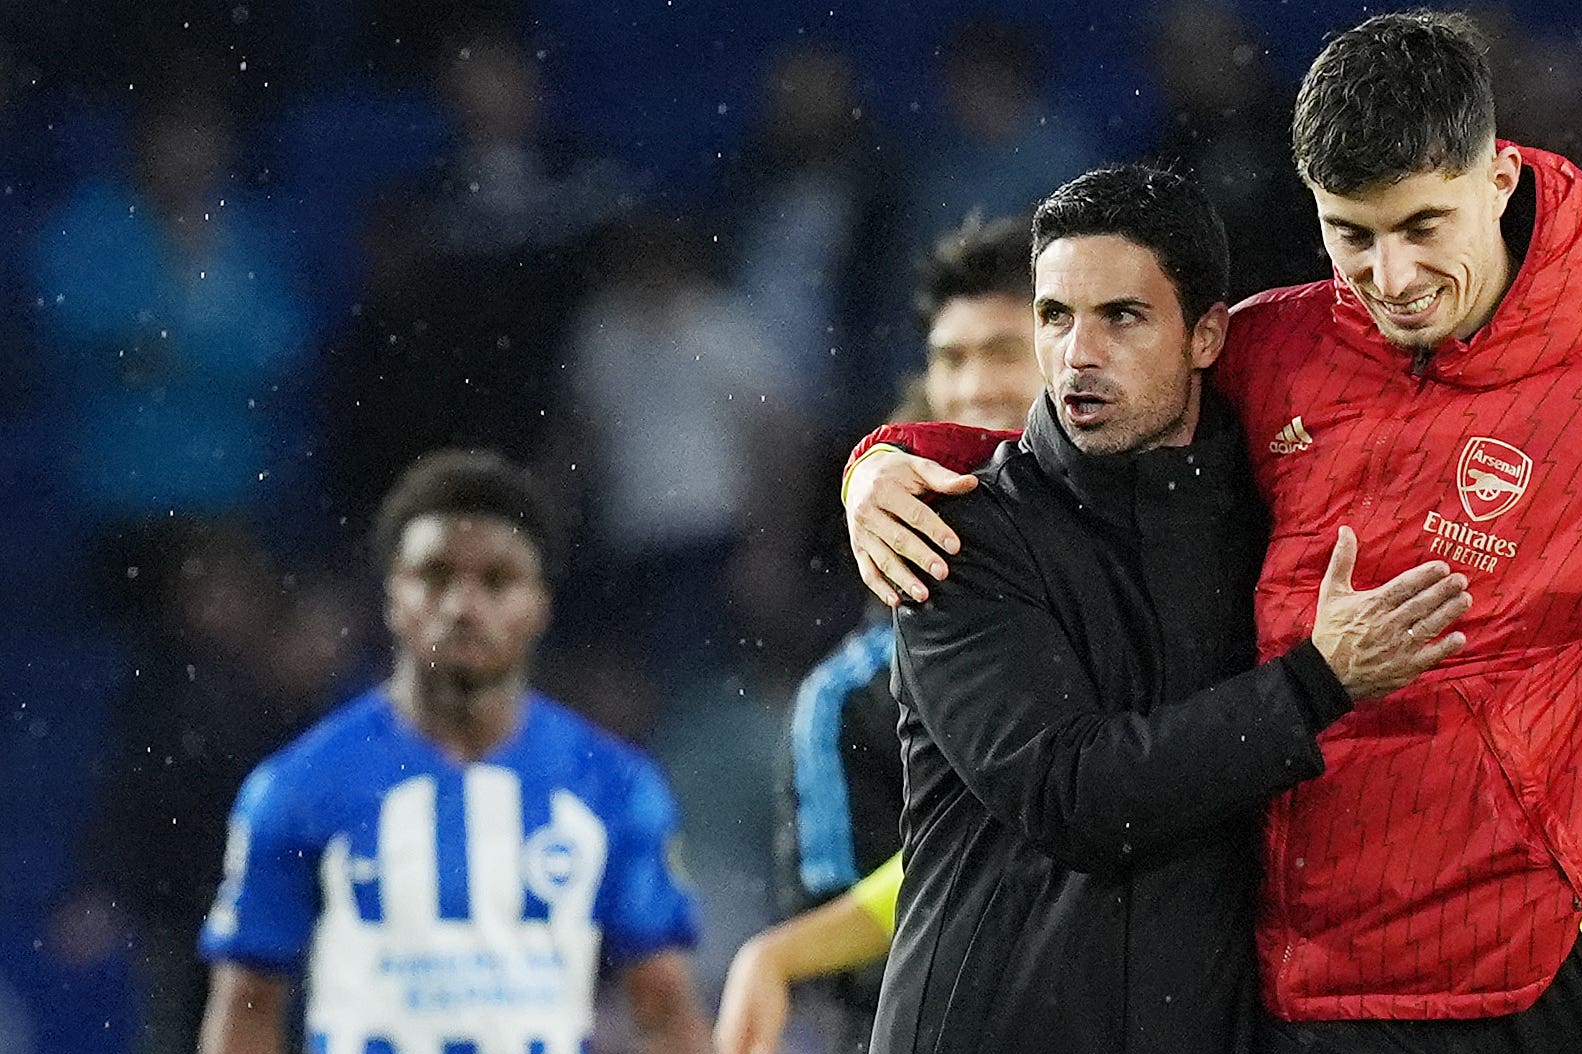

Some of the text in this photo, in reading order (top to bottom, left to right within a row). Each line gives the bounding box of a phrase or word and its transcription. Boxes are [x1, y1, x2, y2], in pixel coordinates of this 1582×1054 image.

[1472, 449, 1521, 478] Arsenal
[1423, 511, 1518, 558] Emirates
[1430, 537, 1498, 574] FLY BETTER
